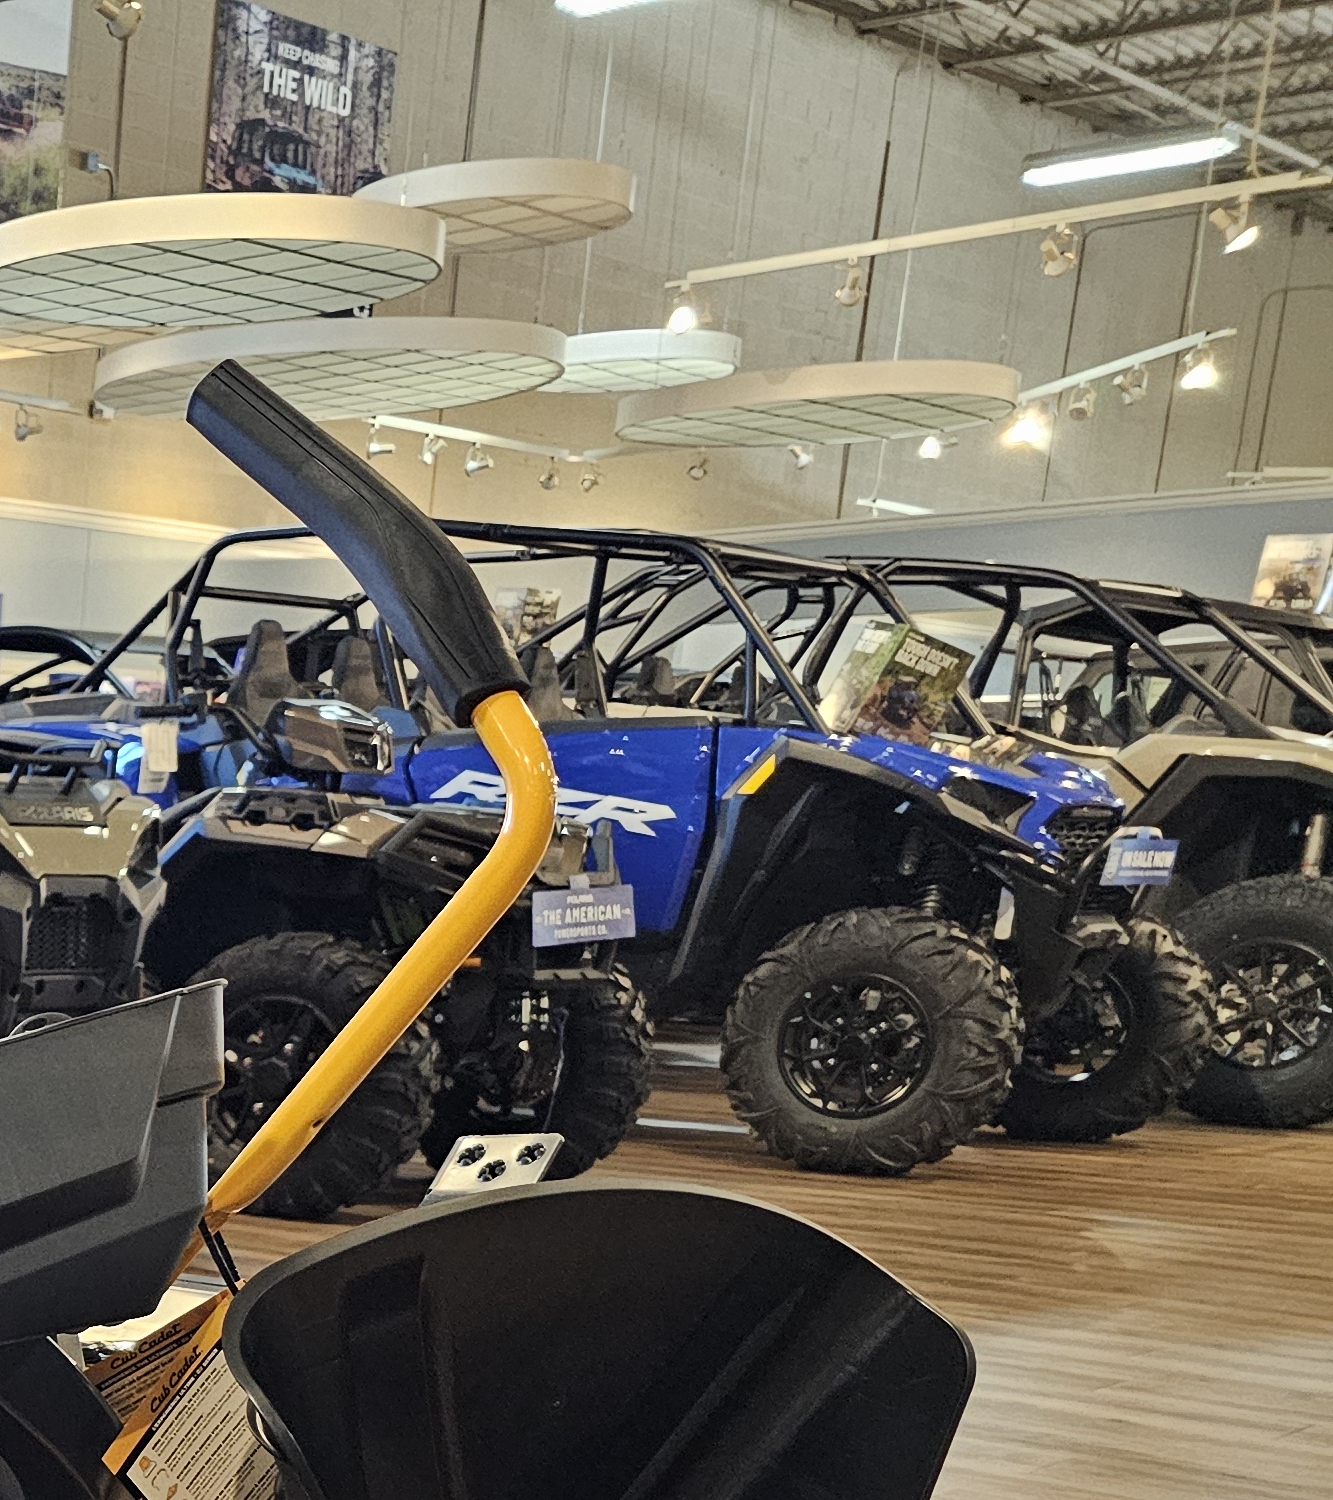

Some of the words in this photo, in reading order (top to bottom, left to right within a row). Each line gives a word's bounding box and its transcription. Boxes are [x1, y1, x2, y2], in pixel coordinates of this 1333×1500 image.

[261, 61, 300, 101] THE
[304, 73, 352, 116] WILD
[542, 908, 563, 926] THE
[564, 903, 622, 924] AMERICAN
[110, 1350, 138, 1370] Cub
[138, 1322, 185, 1354] Cadet
[150, 1385, 171, 1413] Cub
[169, 1345, 202, 1389] Cadet
